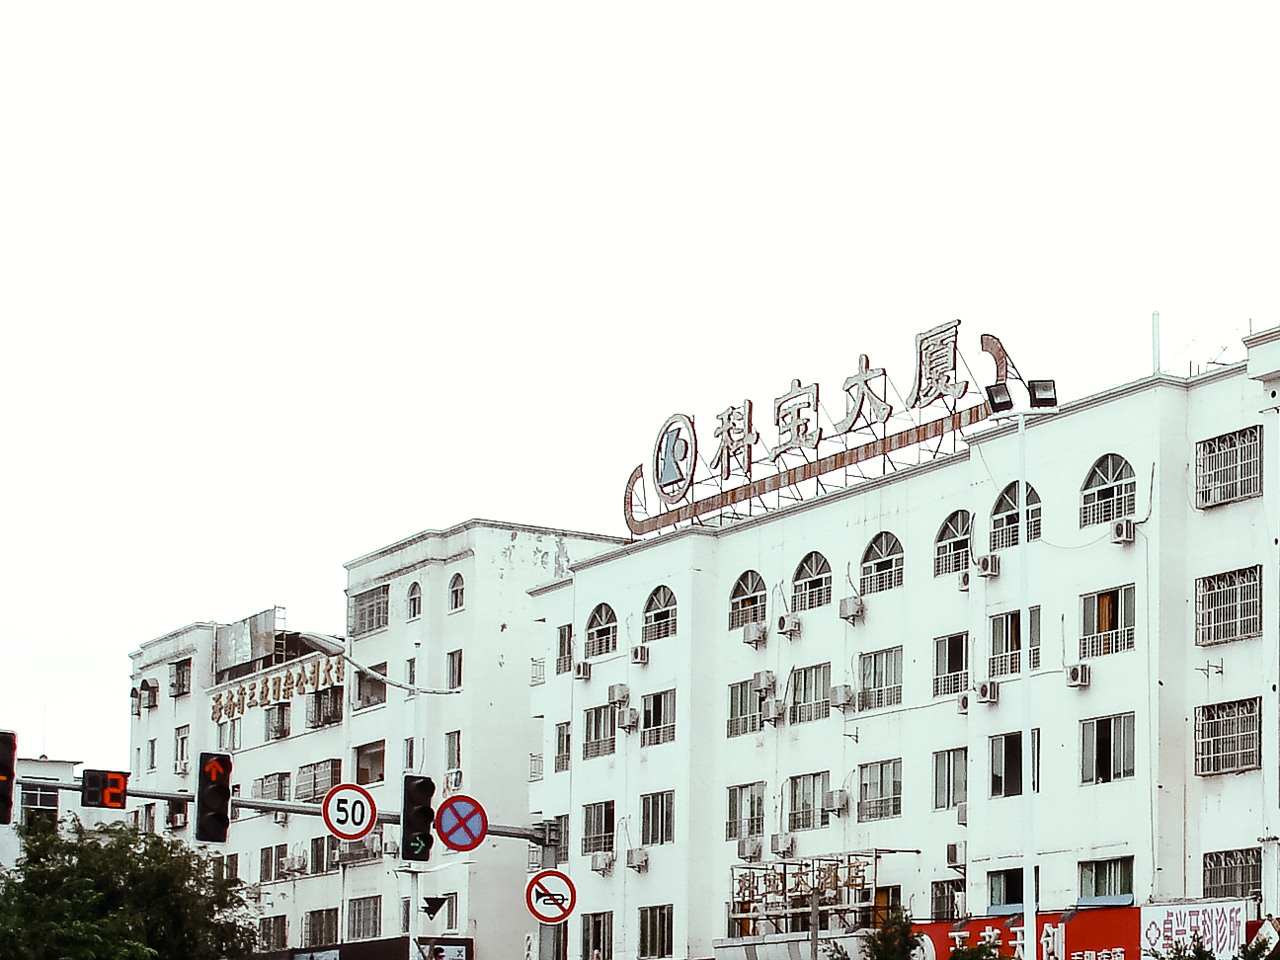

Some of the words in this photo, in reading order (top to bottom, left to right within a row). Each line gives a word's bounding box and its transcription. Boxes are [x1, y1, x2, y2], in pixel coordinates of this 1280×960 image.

[710, 319, 969, 480] 科宝大厦
[103, 772, 126, 807] 2
[335, 797, 366, 827] 50
[735, 858, 871, 901] 科宝大酒店
